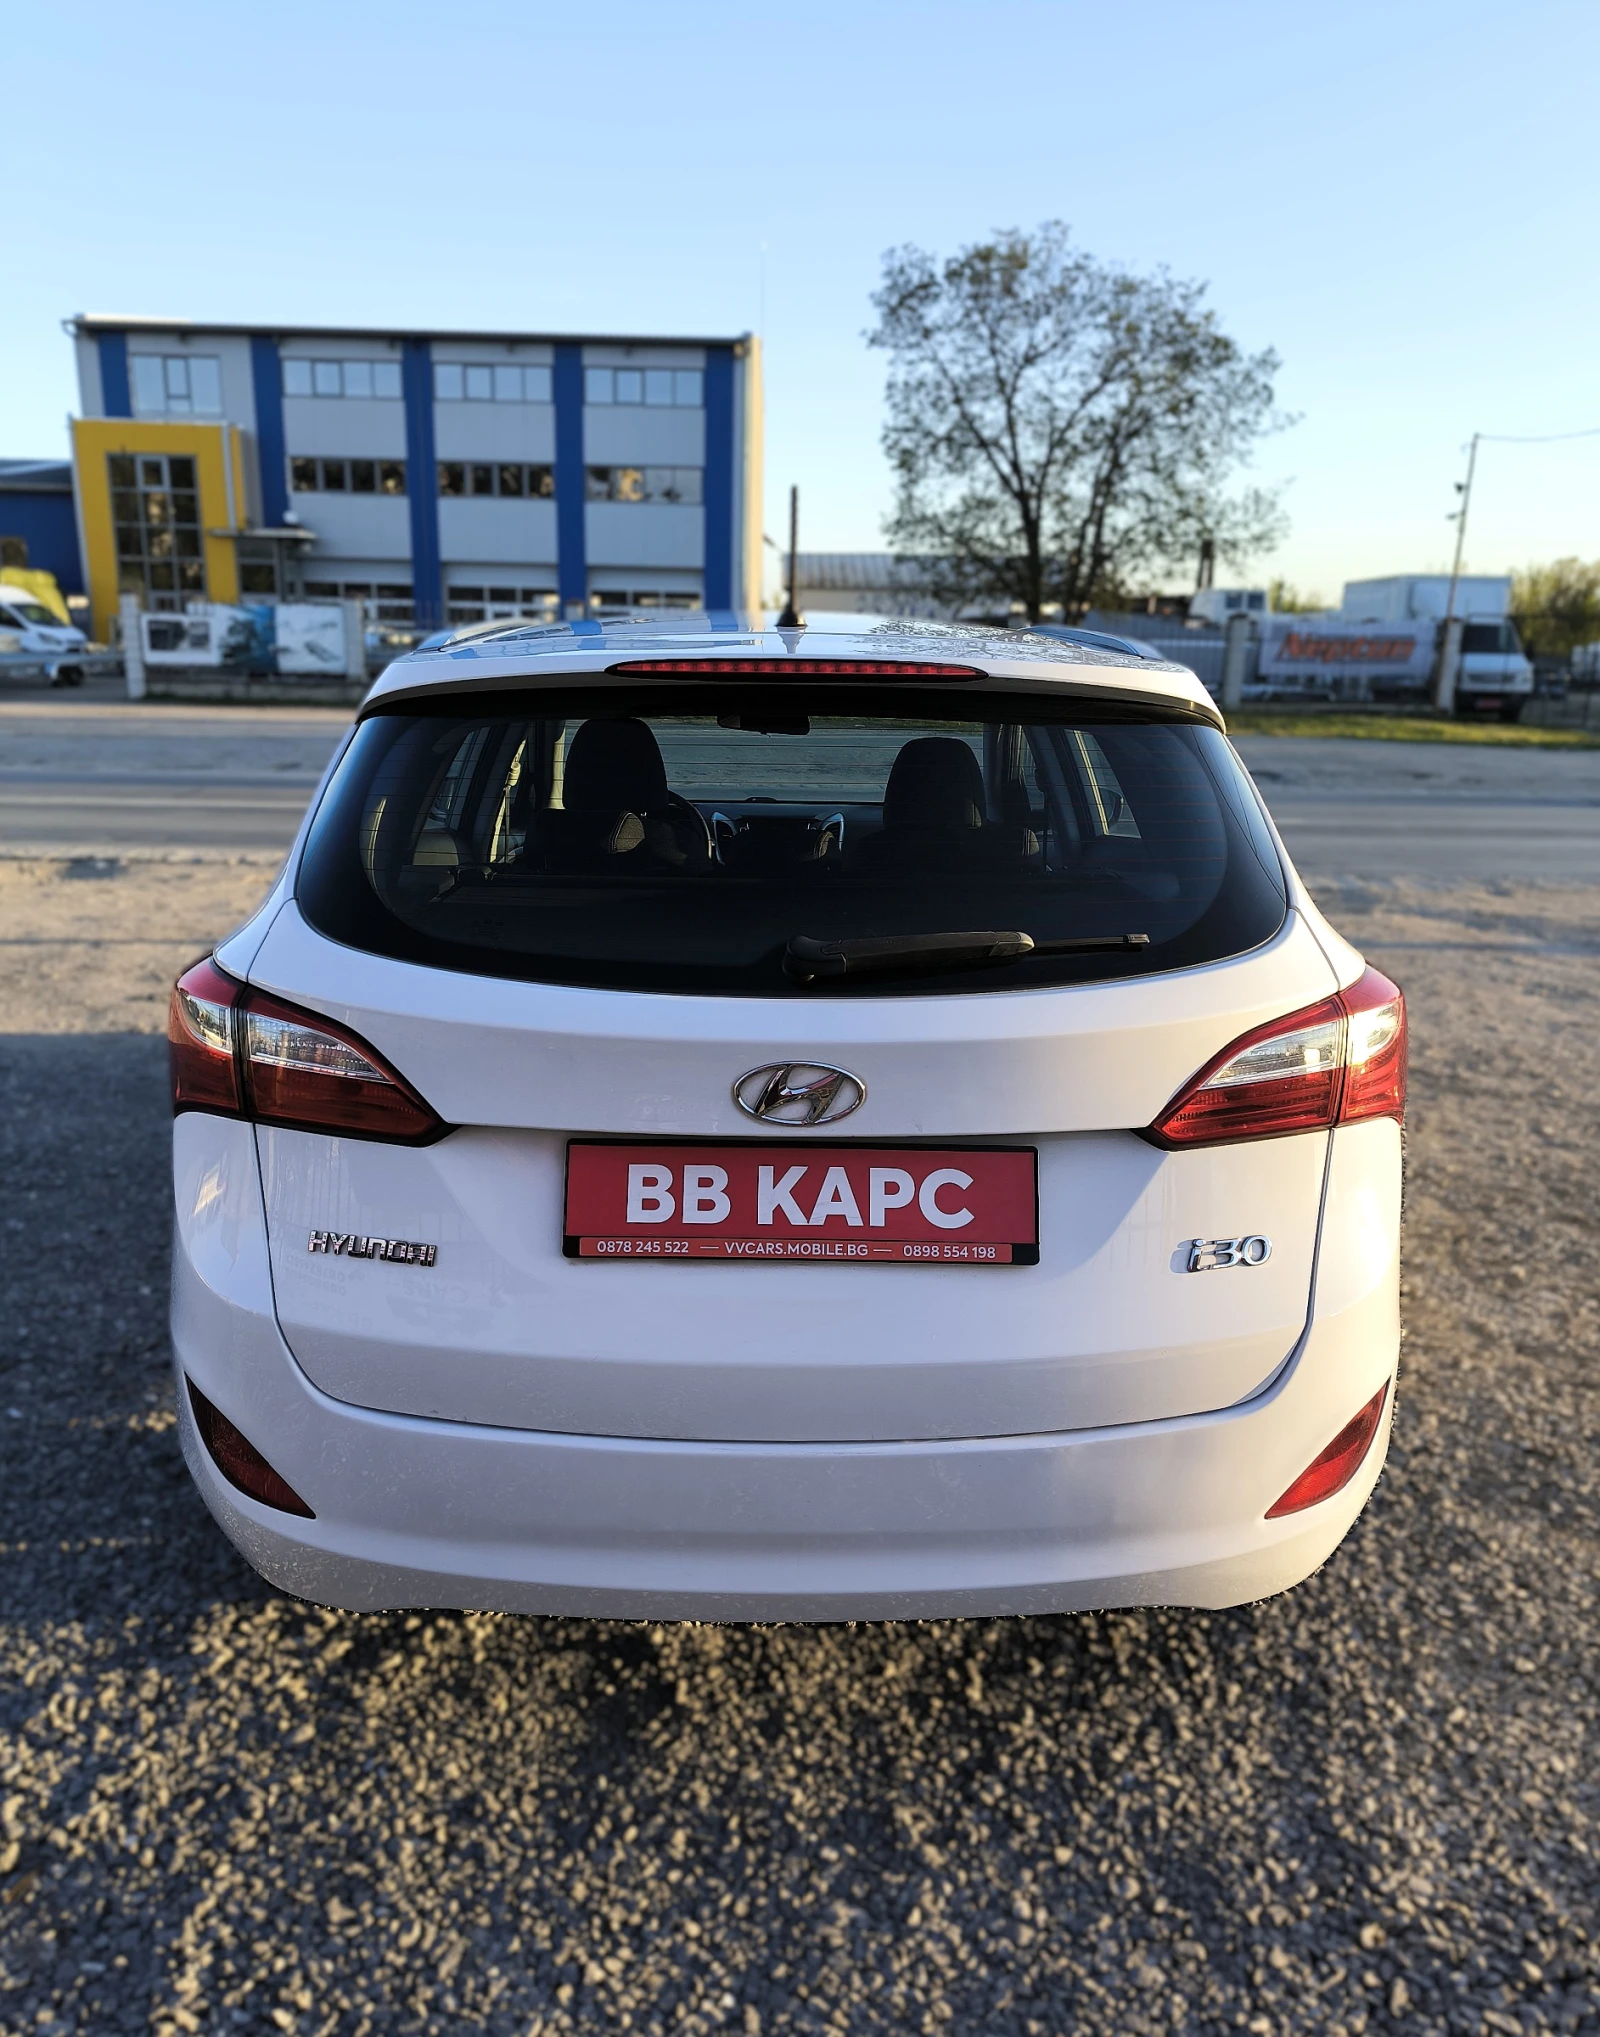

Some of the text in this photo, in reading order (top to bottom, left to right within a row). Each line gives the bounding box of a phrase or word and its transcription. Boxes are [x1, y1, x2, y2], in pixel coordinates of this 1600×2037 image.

[757, 1165, 975, 1228] КАРС
[308, 1229, 437, 1267] HYUNDAI
[597, 1241, 996, 1259] 0878 245 522 VVCARS.MOBILE.BG 0898 554 198
[1187, 1234, 1272, 1273] i30
